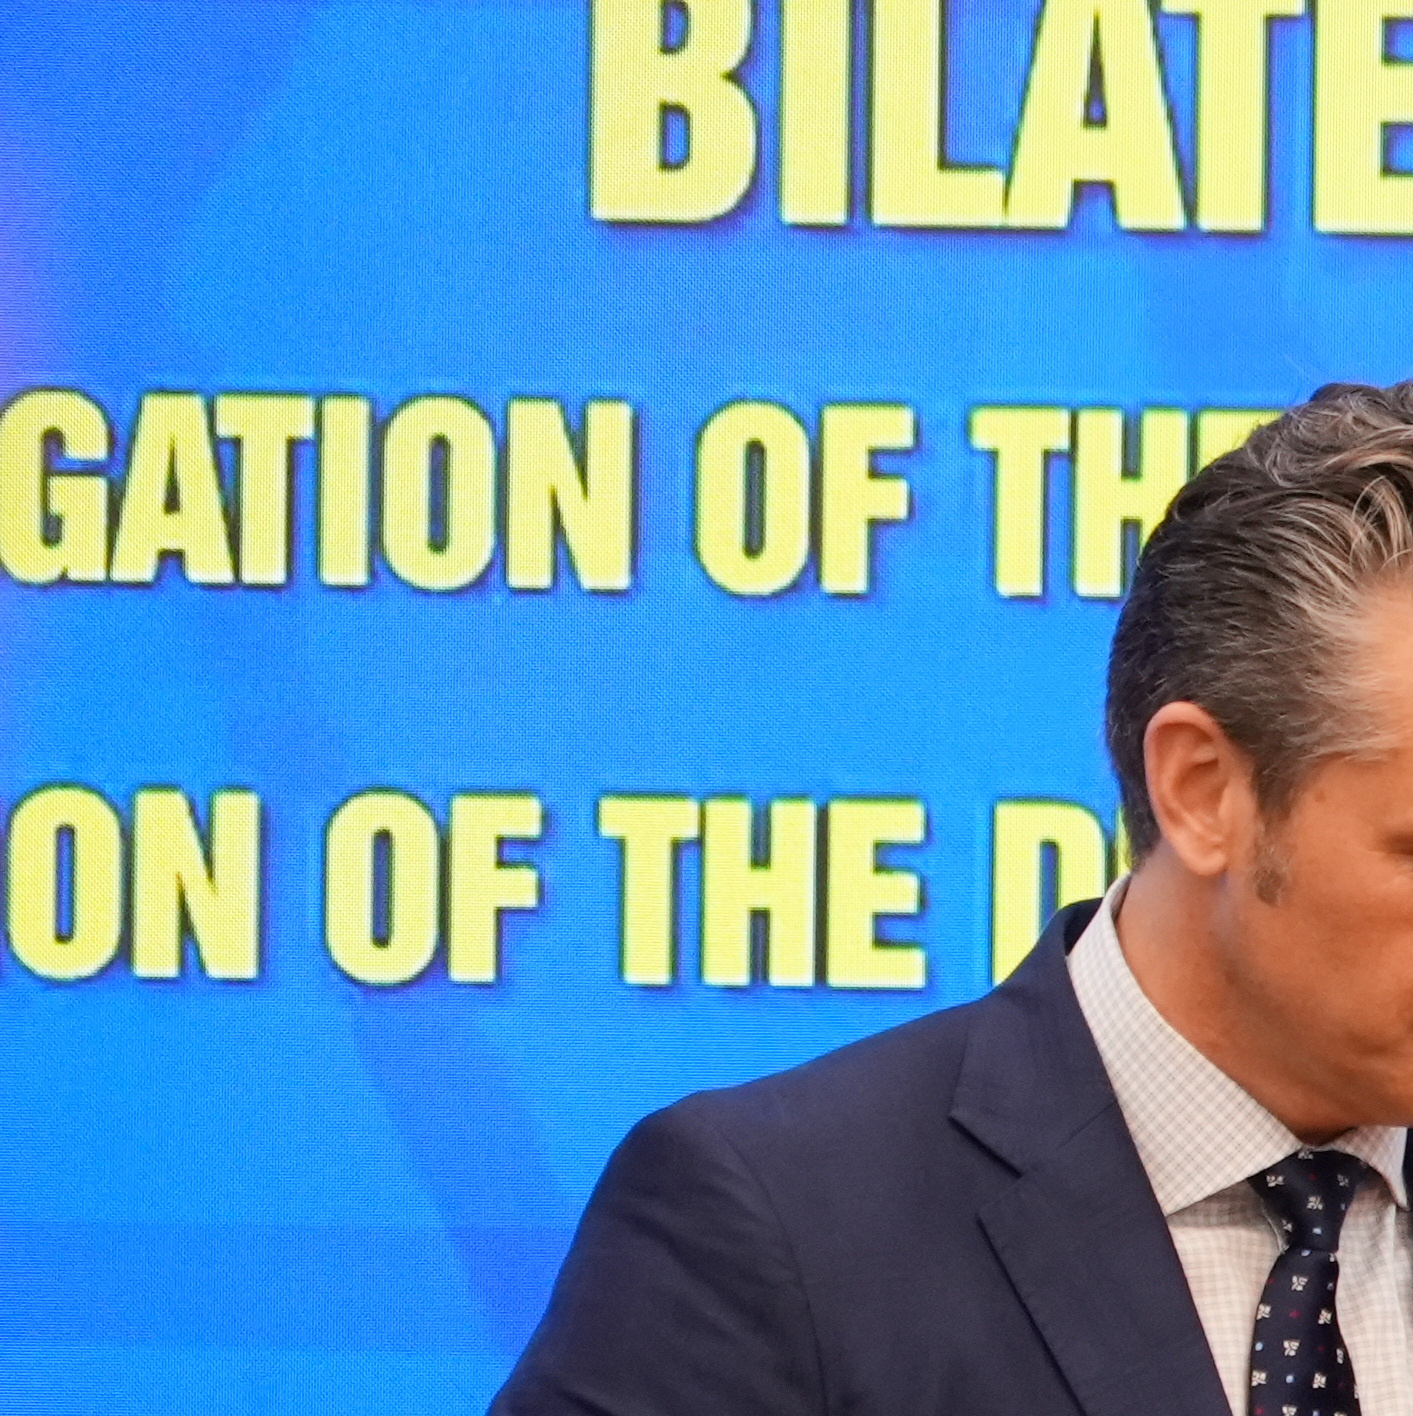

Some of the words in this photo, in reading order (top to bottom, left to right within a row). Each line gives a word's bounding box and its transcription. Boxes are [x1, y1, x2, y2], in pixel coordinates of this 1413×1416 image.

[0, 389, 635, 592] GATION
[694, 400, 915, 596] OF
[5, 786, 261, 982] ON
[324, 791, 544, 985] OF
[597, 795, 926, 989] THE
